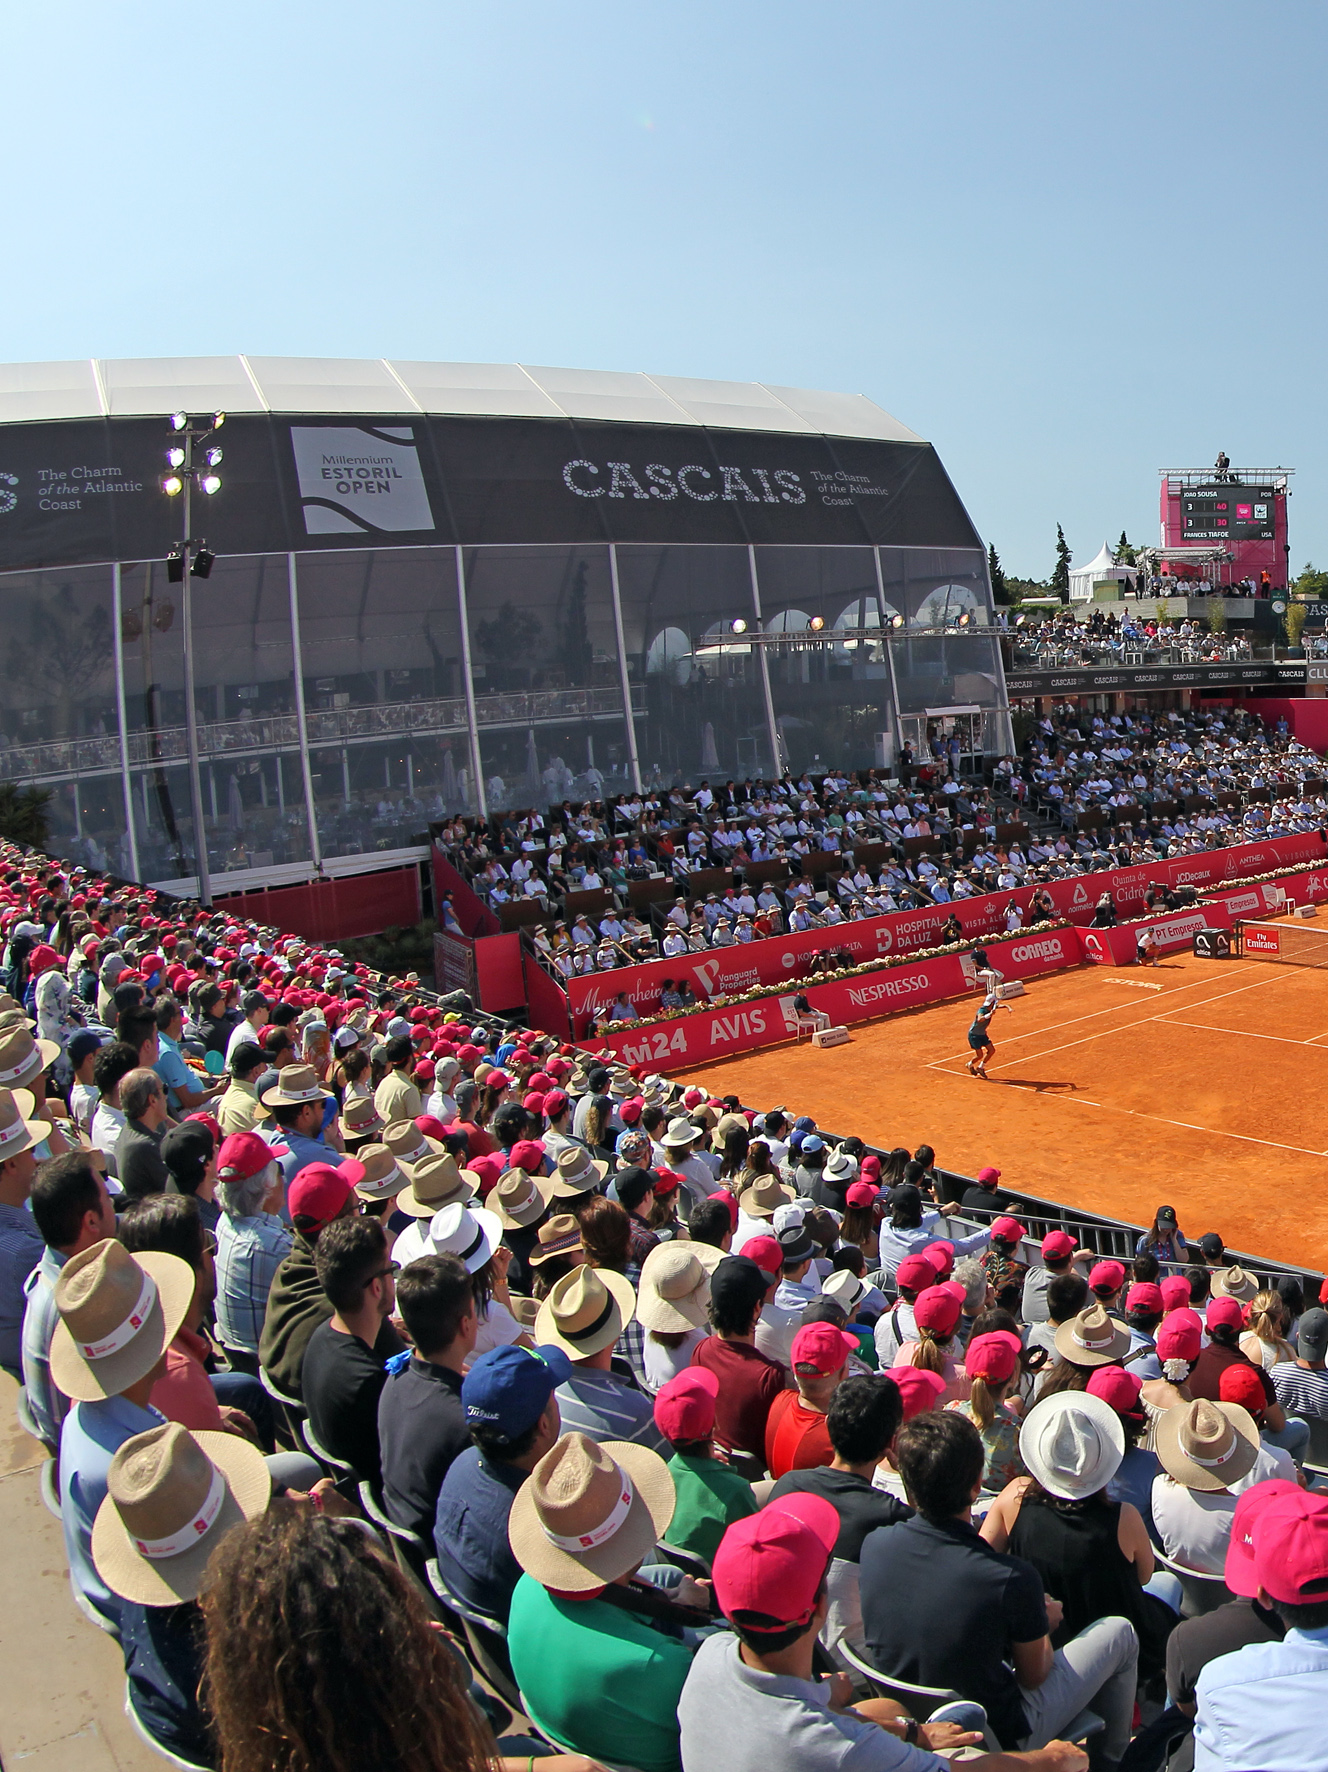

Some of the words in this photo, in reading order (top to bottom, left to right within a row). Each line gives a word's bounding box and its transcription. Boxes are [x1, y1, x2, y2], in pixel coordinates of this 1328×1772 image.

[322, 453, 393, 464] Millennium
[38, 469, 67, 481] The
[71, 466, 122, 479] Charm
[321, 467, 402, 479] ESTORIL
[810, 471, 833, 481] The
[835, 471, 870, 483] Charm
[38, 484, 55, 495] of
[57, 483, 79, 494] the
[84, 480, 143, 493] Atlantic
[336, 481, 391, 494] OPEN
[562, 459, 806, 505] CASCAIS
[818, 483, 827, 493] of
[830, 483, 847, 493] the
[849, 484, 889, 496] Atlantic
[39, 499, 82, 511] Coast
[822, 496, 854, 506] Coast
[1187, 503, 1193, 511] 3
[1187, 519, 1193, 527] 3
[1217, 519, 1227, 527] 30
[1134, 674, 1157, 682] CASCAIS
[1172, 673, 1194, 681] CASCAIS
[1278, 670, 1304, 678] CASCAIS
[1051, 678, 1077, 687] CASCAIS
[1094, 676, 1118, 685] CASCAIS
[1239, 853, 1265, 865] ANTHEA
[1112, 873, 1137, 887] Quinta
[1138, 871, 1146, 881] de
[1175, 870, 1211, 884] JCDecaux
[1117, 884, 1145, 902] Cidrô
[1068, 902, 1094, 913] normetal
[896, 916, 943, 935] HOSPITAL
[964, 919, 987, 929] VISTA
[988, 915, 1003, 924] ALE
[1156, 927, 1168, 939] PT
[1257, 933, 1267, 941] Fly
[897, 936, 912, 948] DA
[913, 931, 933, 945] LUZ
[1246, 938, 1278, 950] Emirates
[1011, 939, 1062, 962] CORREIO
[1085, 953, 1104, 961] altice
[719, 967, 758, 982] Vanguard
[719, 976, 761, 991] Properties
[1102, 977, 1165, 990] ESTORIL
[845, 974, 930, 1006] NESPRESSO
[710, 1009, 766, 1045] AVIS
[622, 1027, 687, 1065] tvi24
